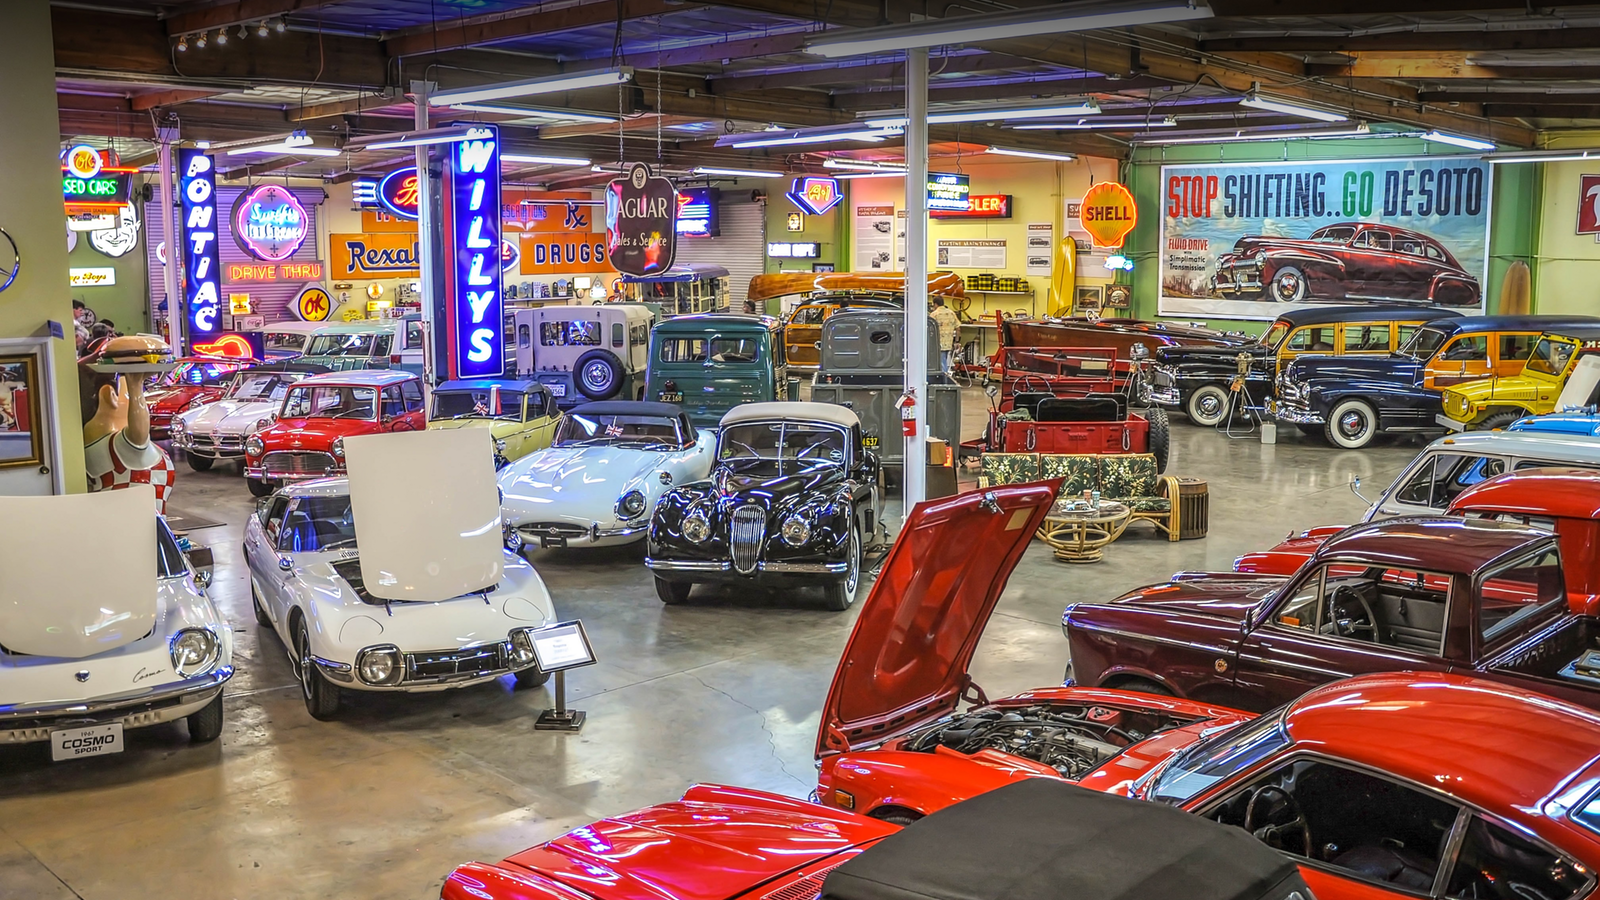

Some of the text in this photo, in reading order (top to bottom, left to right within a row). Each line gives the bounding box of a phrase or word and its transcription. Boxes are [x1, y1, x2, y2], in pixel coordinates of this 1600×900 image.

[75, 152, 96, 170] OK
[64, 180, 117, 195] SED CARS
[1168, 175, 1219, 218] STOP
[1342, 170, 1375, 218] GO
[1383, 167, 1484, 217] DESOTO
[617, 197, 669, 219] AGUAR
[967, 198, 1001, 211] SLER
[1086, 206, 1131, 221] SHELL
[187, 155, 218, 332] PONTIAC
[460, 140, 496, 362] WILLYS
[1168, 239, 1208, 251] FLUID DRIVE
[534, 242, 605, 265] DRUGS
[1169, 255, 1206, 263] Simplimatic
[231, 264, 321, 279] DRIVE THRU
[1169, 263, 1206, 271] Transmission
[304, 293, 324, 316] OK
[132, 667, 166, 683] Cosmo
[62, 734, 115, 749] COSMO
[74, 745, 103, 755] SPORT
